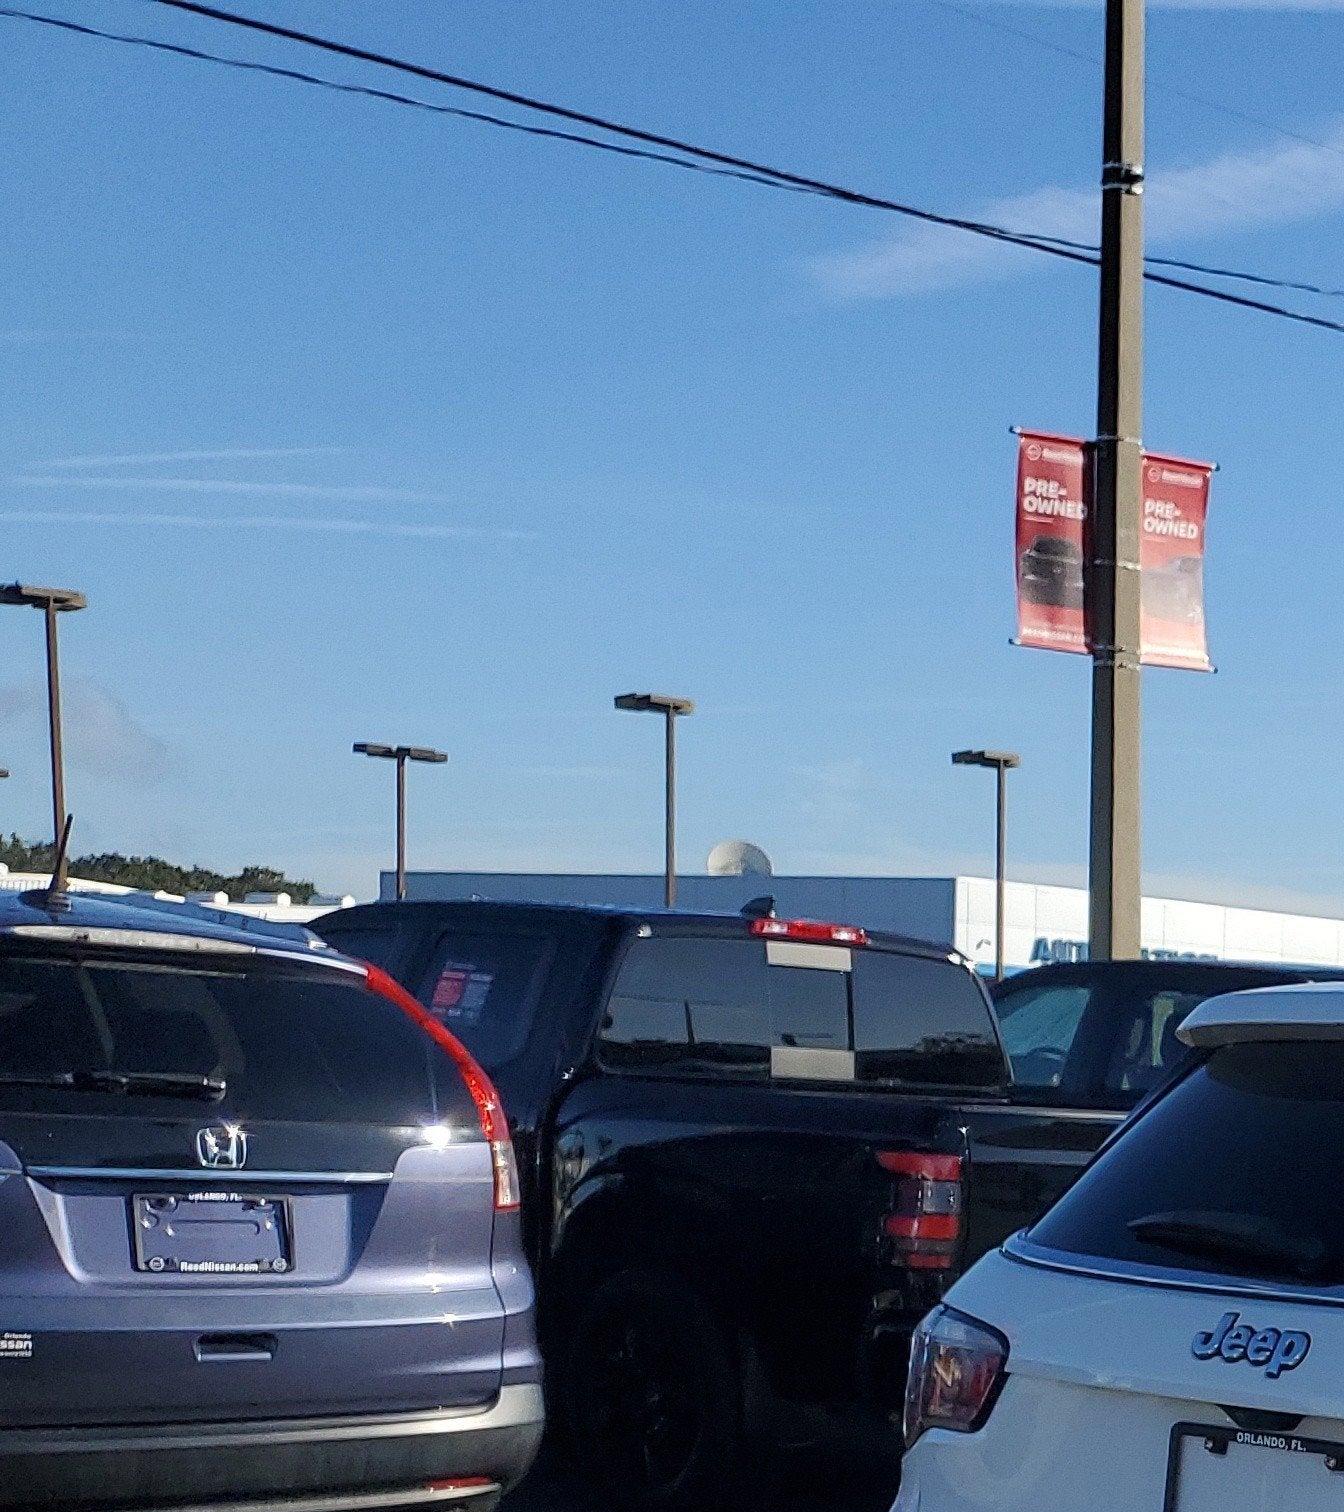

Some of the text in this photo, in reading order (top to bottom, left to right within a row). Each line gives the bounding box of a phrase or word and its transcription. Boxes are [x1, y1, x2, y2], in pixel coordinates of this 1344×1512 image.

[1024, 476, 1067, 499] PRE-
[1023, 495, 1088, 520] OWNED
[1145, 498, 1182, 519] PRE-
[1143, 517, 1199, 540] OWNED
[1191, 1311, 1312, 1380] Jeep
[1236, 1431, 1290, 1450] ORLANDO,
